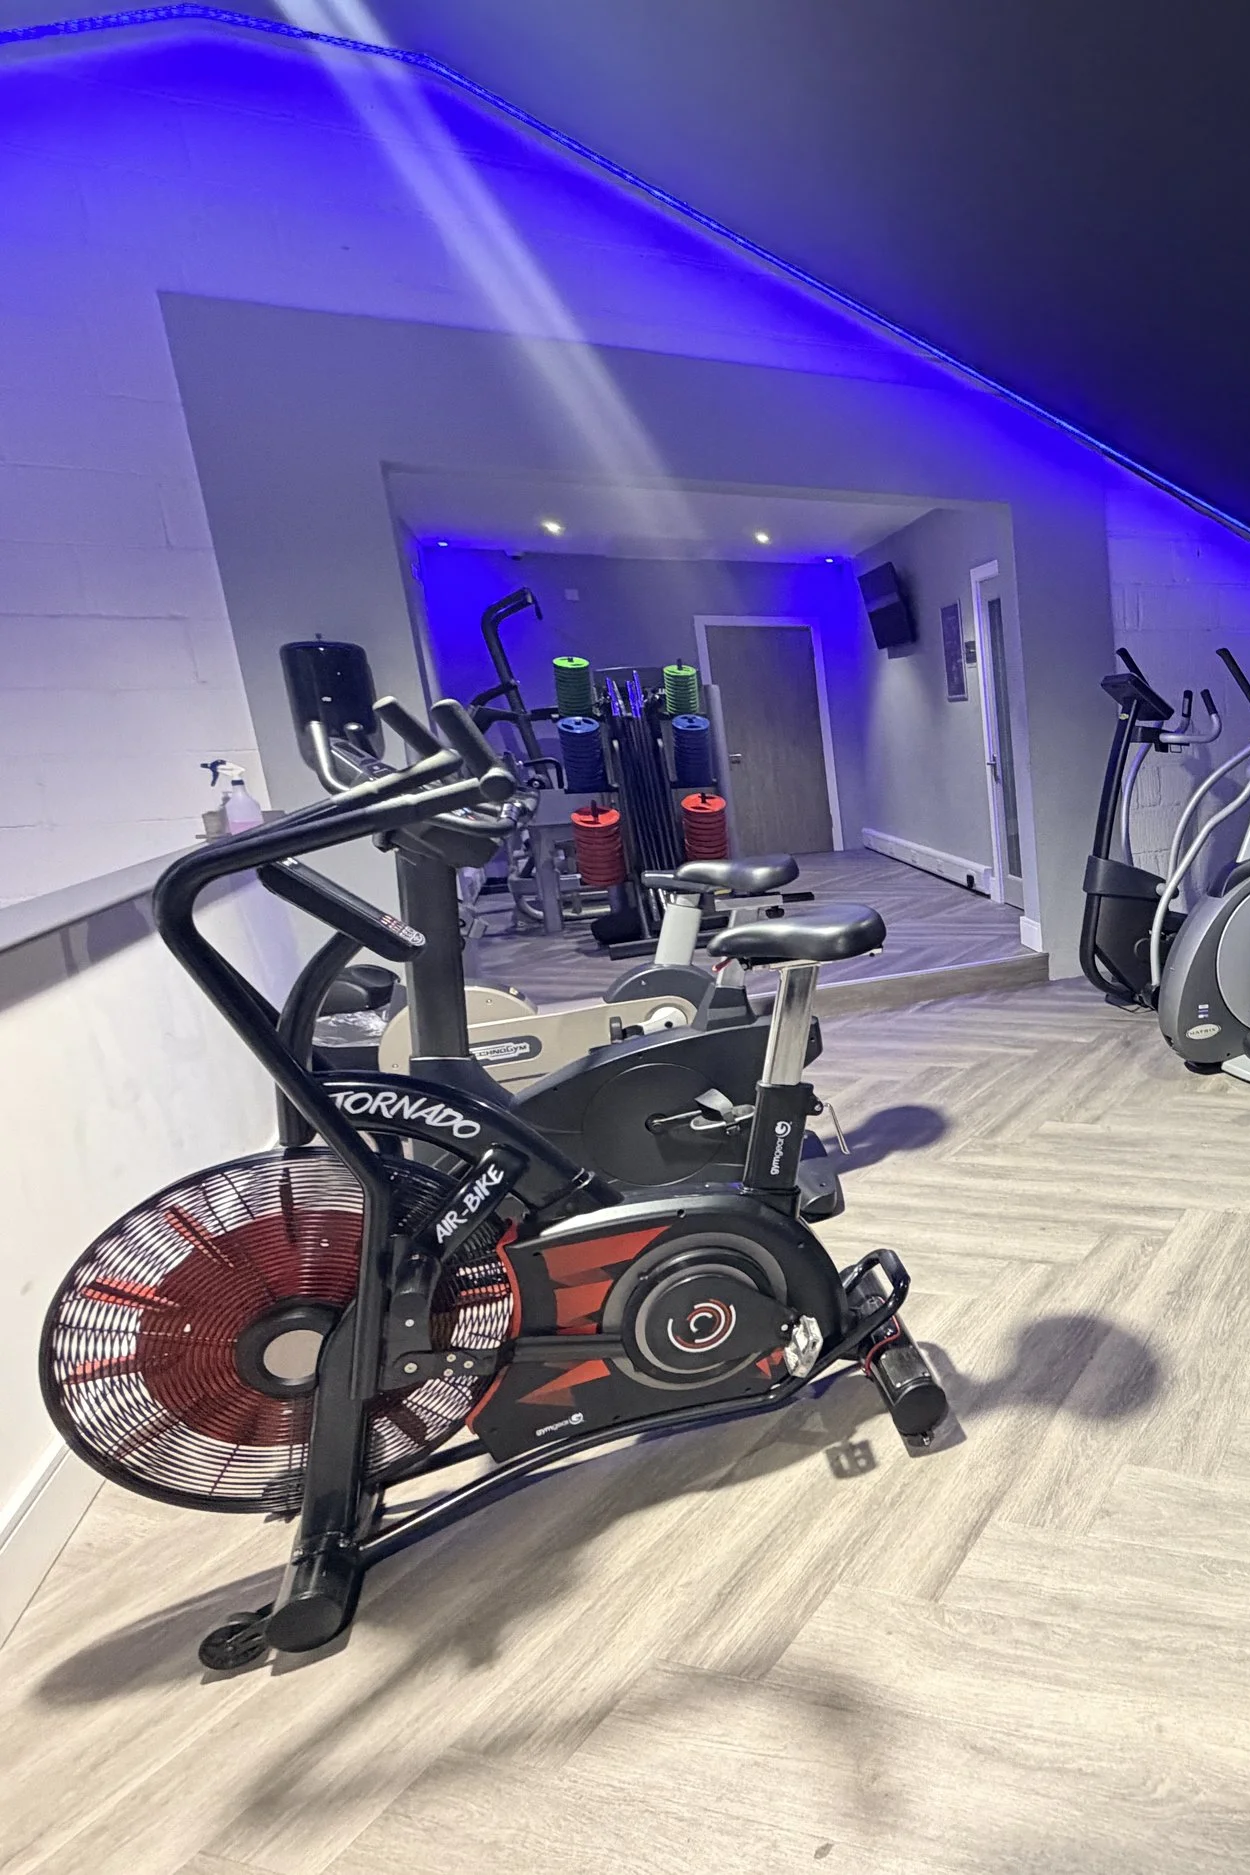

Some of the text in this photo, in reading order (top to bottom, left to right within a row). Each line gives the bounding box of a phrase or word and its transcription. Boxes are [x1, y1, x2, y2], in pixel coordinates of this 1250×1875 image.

[328, 1091, 482, 1139] TORNADO
[770, 1137, 785, 1175] gymgear
[435, 1164, 505, 1244] AIR-BIKE
